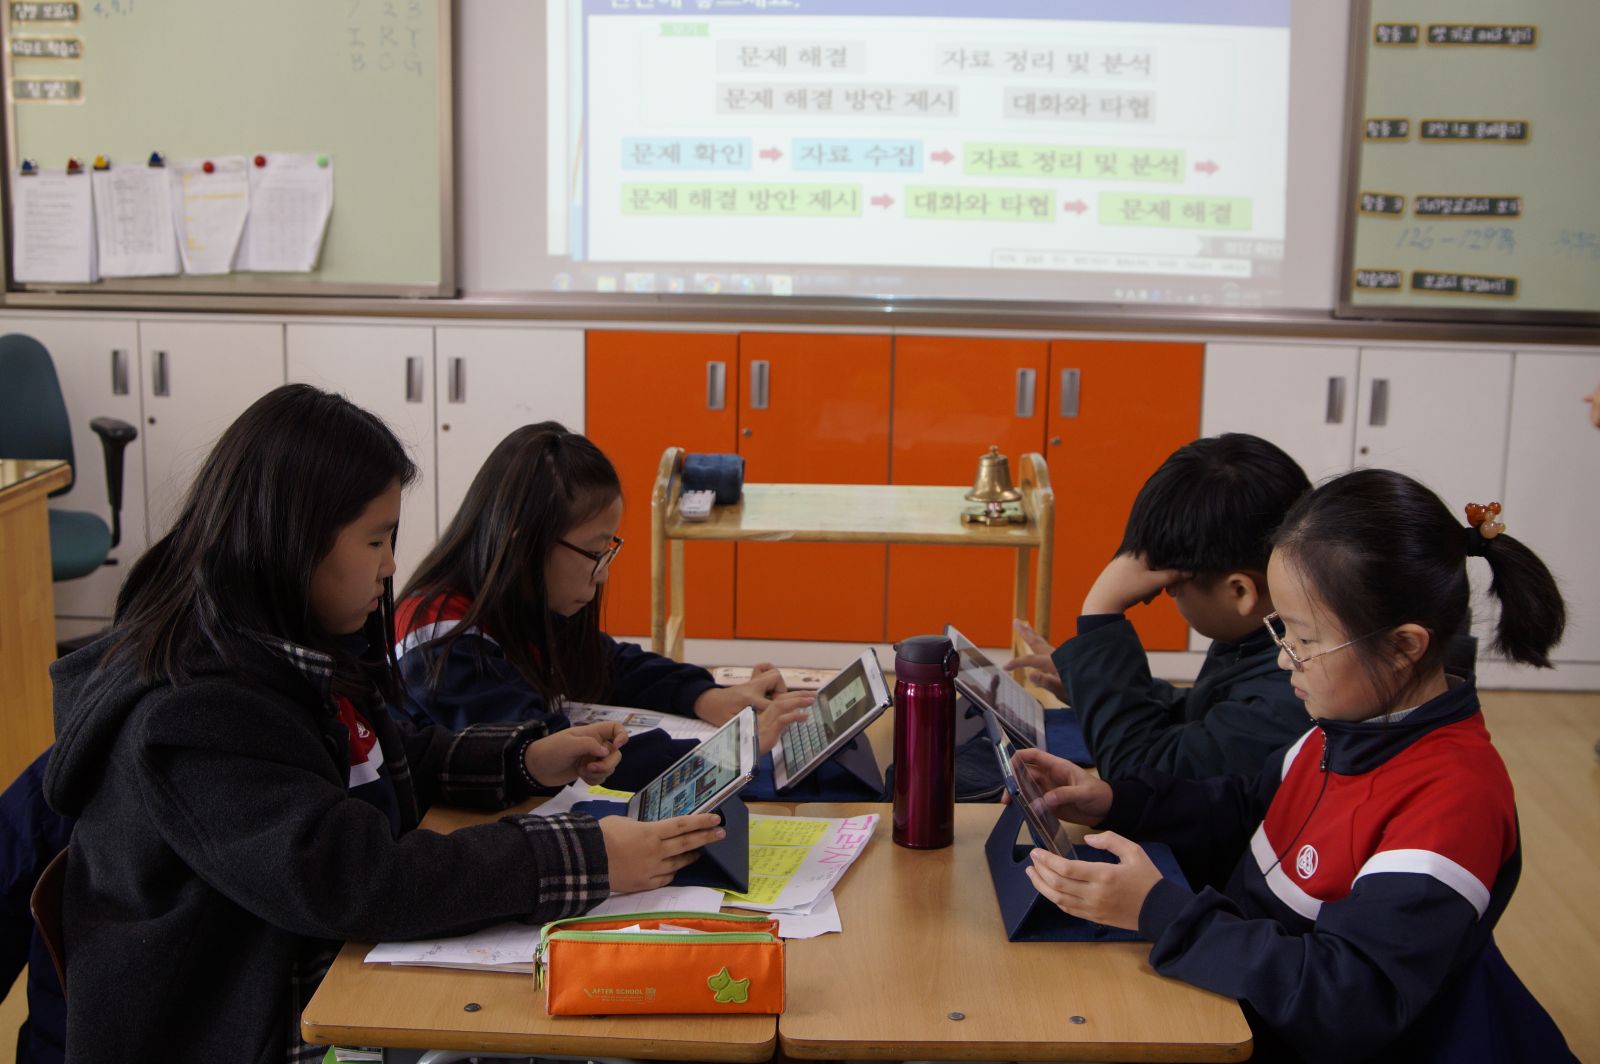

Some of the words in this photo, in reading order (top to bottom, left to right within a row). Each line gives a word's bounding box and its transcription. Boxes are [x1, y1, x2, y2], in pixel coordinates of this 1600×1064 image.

[380, 26, 398, 46] R
[738, 46, 788, 68] 문제
[799, 46, 848, 68] 해결
[942, 48, 995, 69] 자료
[1004, 49, 1054, 74] 정리
[1066, 51, 1090, 74] 및
[1101, 52, 1152, 76] 분석
[724, 88, 774, 111] 문제
[784, 88, 833, 111] 해결
[845, 89, 896, 112] 방안
[905, 90, 955, 113] 제시
[1013, 92, 1090, 117] 대화와
[1100, 94, 1150, 119] 타협
[630, 143, 681, 165] 문제
[694, 142, 744, 165] 확인
[800, 144, 853, 165] 자료
[864, 144, 915, 168] 수집
[970, 149, 1022, 170] 자료
[1032, 150, 1082, 174] 정리
[1094, 152, 1118, 176] 및
[1129, 154, 1181, 178] 분석
[628, 188, 678, 210] 문제
[688, 188, 737, 211] 해결
[748, 189, 799, 211] 방안
[808, 189, 858, 213] 제시
[914, 193, 989, 215] 대화와
[1000, 193, 1050, 218] 타협
[1120, 199, 1171, 222] 문제
[1182, 201, 1233, 226] 해결
